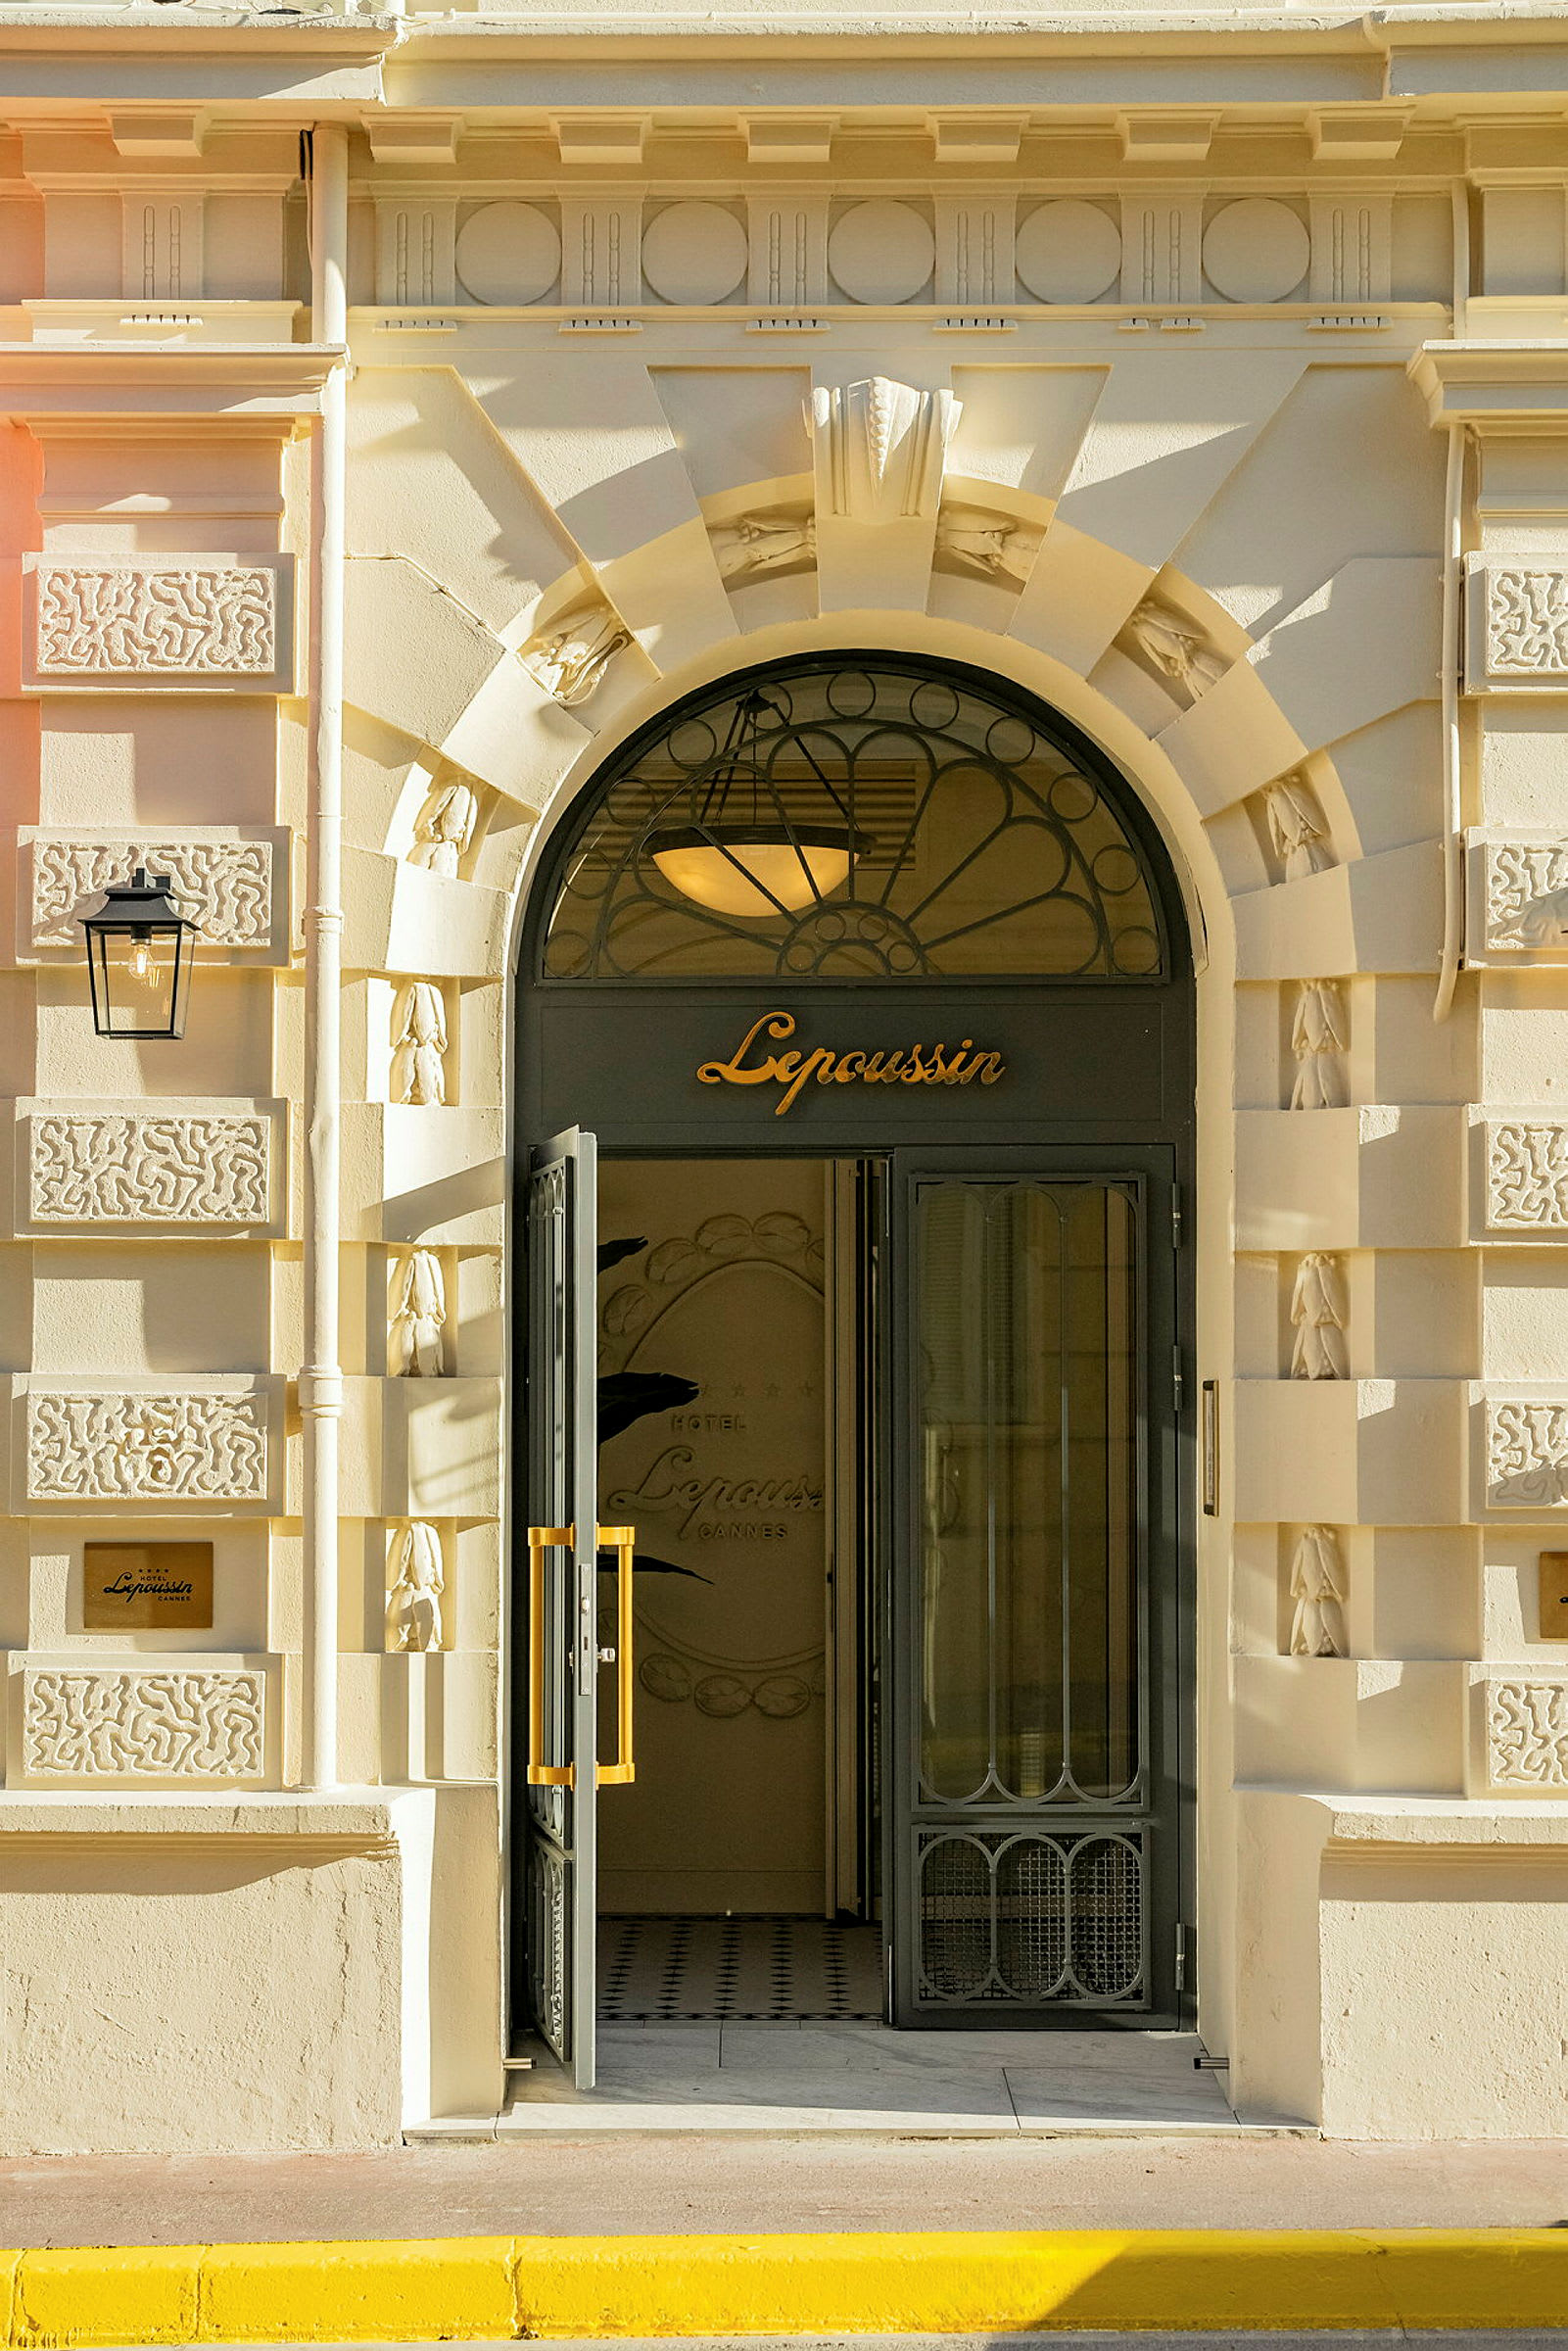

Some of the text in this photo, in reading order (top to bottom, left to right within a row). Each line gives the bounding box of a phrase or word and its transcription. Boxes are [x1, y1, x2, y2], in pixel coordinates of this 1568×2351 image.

[696, 1011, 1006, 1116] Lepoussin
[671, 1415, 746, 1431] HOTEL
[698, 1522, 787, 1539] CANNES
[103, 1571, 194, 1603] Lepoussin
